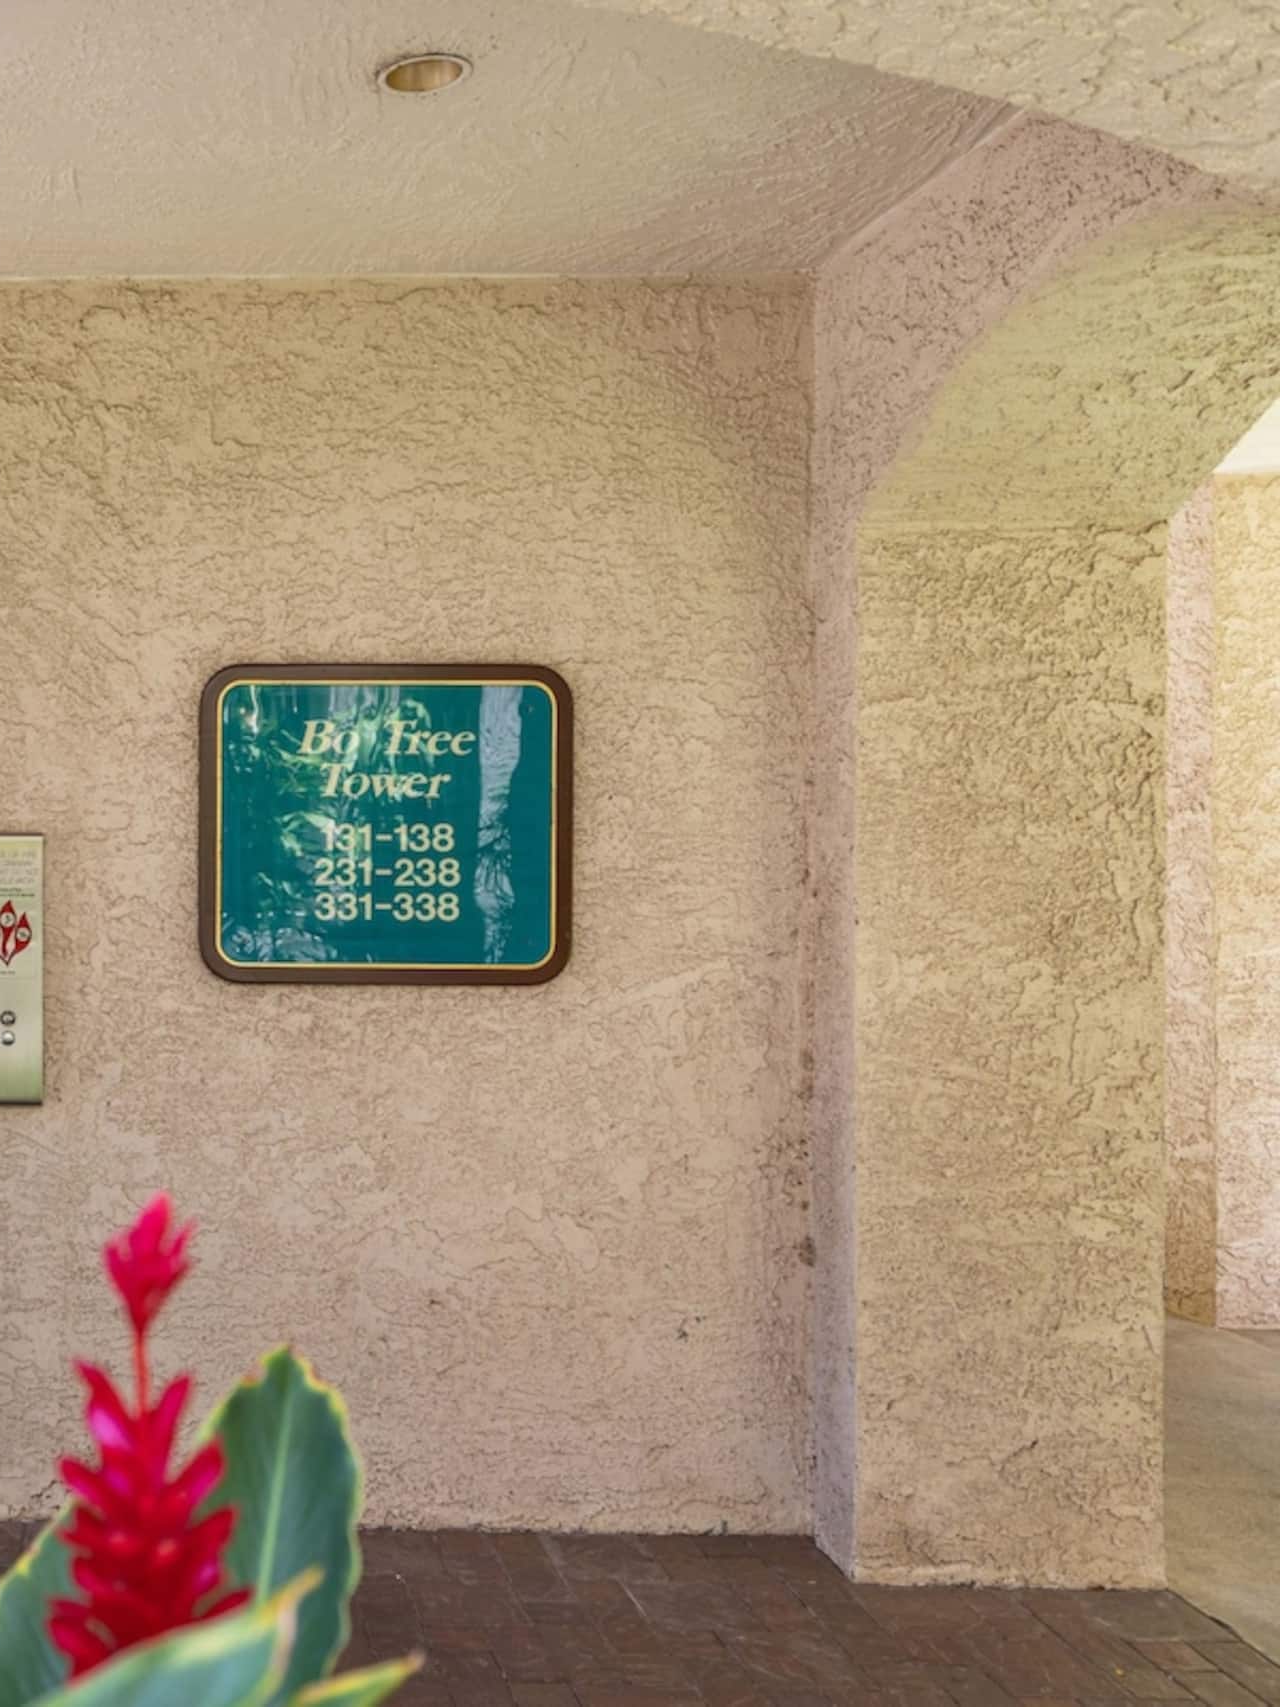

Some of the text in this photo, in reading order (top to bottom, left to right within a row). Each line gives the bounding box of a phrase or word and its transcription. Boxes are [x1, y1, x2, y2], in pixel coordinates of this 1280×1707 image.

[297, 718, 477, 757] Bo Tree
[320, 761, 453, 799] Tower
[322, 823, 455, 852] 131-138
[314, 858, 461, 888] 231-238
[314, 893, 461, 922] 331-338
